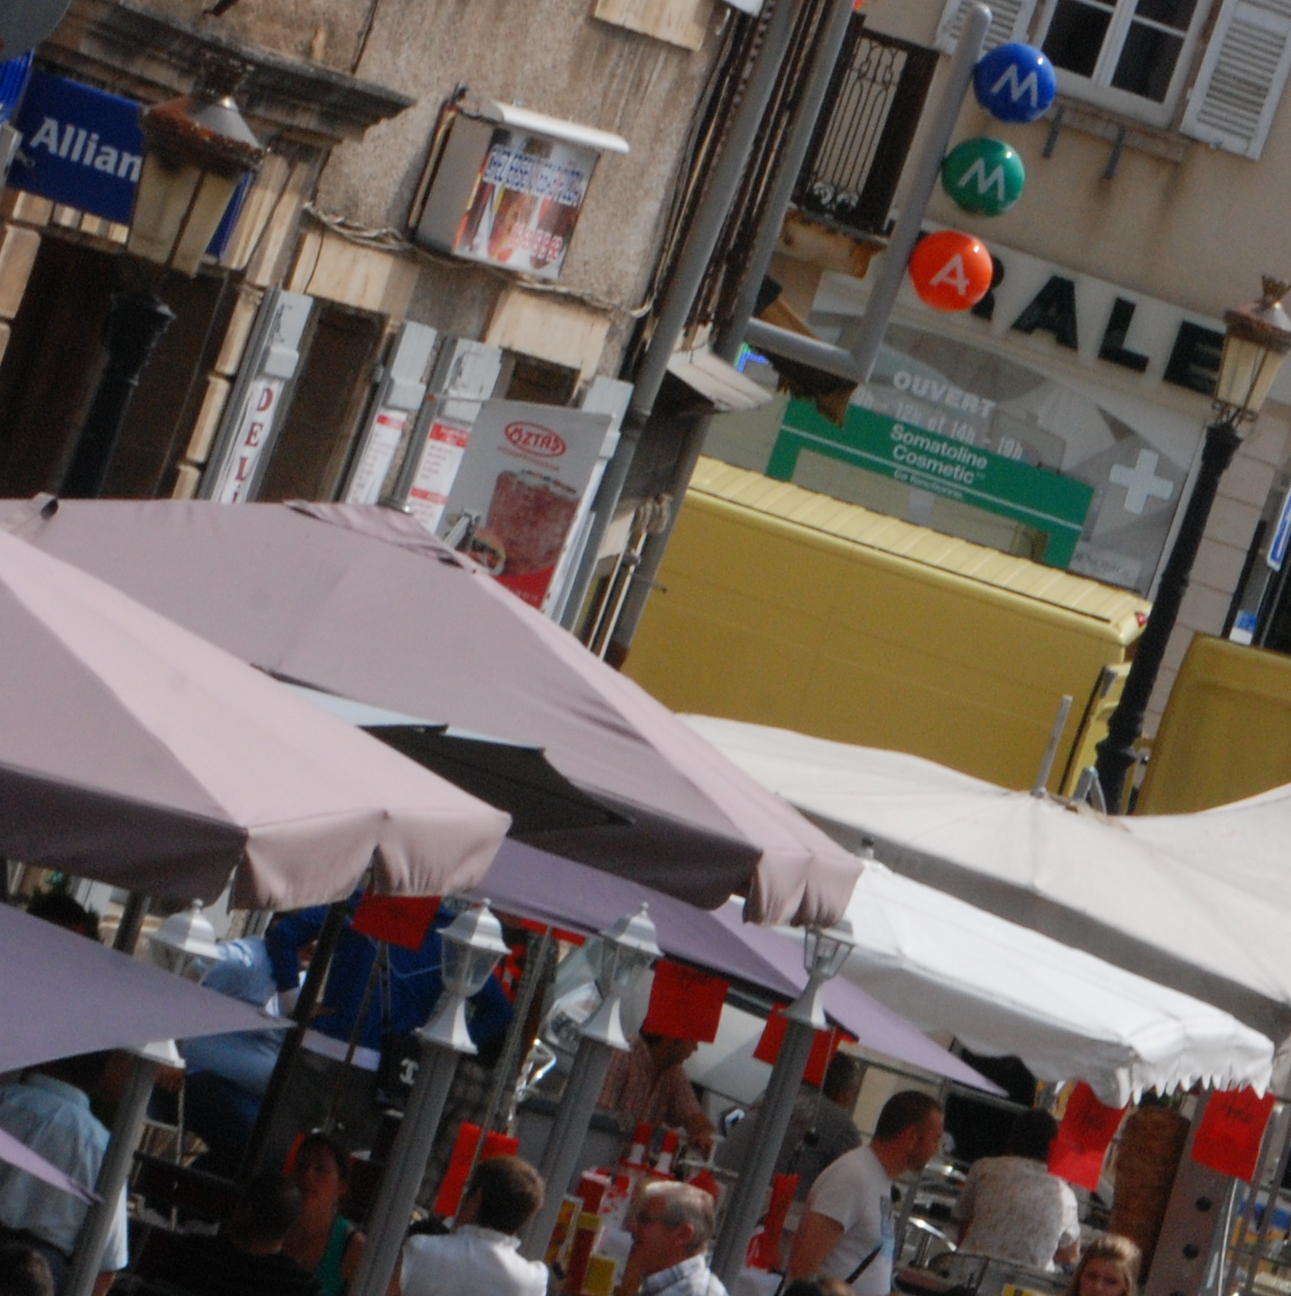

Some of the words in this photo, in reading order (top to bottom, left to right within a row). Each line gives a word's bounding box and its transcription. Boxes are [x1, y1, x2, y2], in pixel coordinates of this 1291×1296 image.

[991, 63, 1039, 107] M
[958, 158, 1006, 201] M
[930, 254, 970, 296] A
[893, 370, 996, 418] OUVERT
[891, 425, 988, 469] Somatoline
[951, 421, 977, 445] 14h
